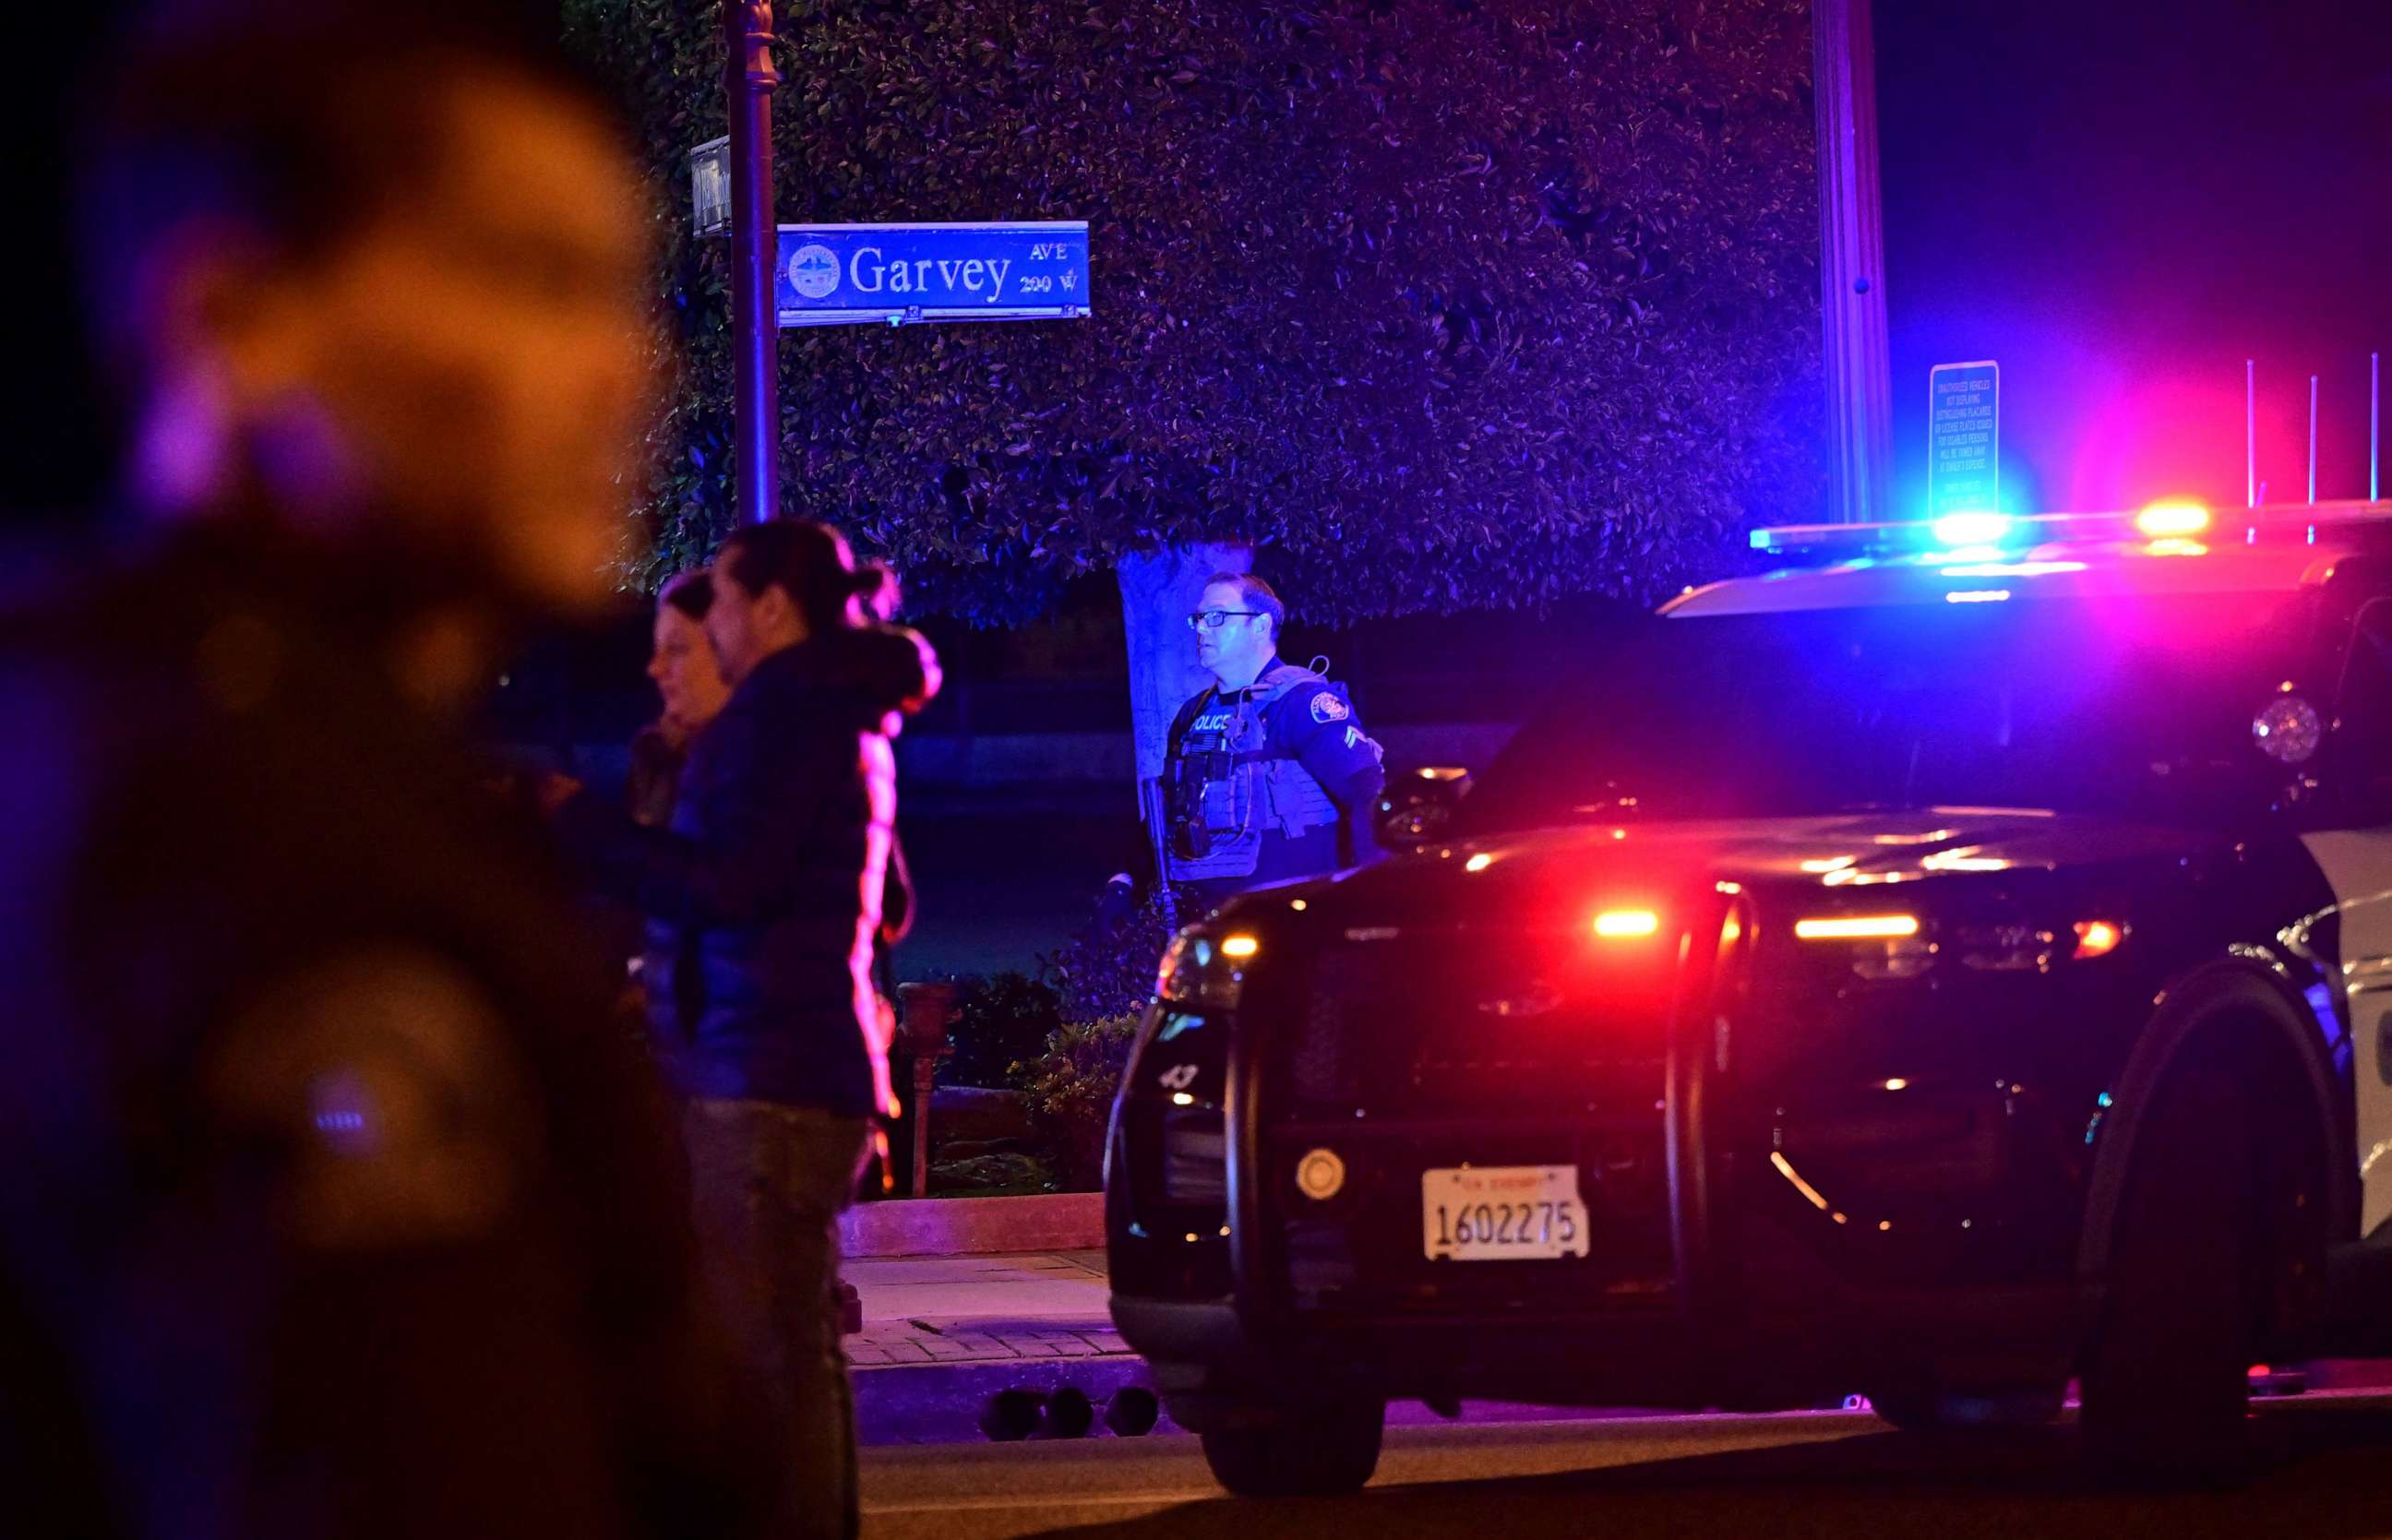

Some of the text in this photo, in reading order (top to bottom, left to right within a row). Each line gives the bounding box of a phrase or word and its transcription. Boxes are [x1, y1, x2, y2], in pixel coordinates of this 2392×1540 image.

[1030, 243, 1068, 260] AVE
[850, 247, 1011, 303] Garvey
[1020, 274, 1078, 293] 200 W
[1437, 1201, 1575, 1245] 1602275
